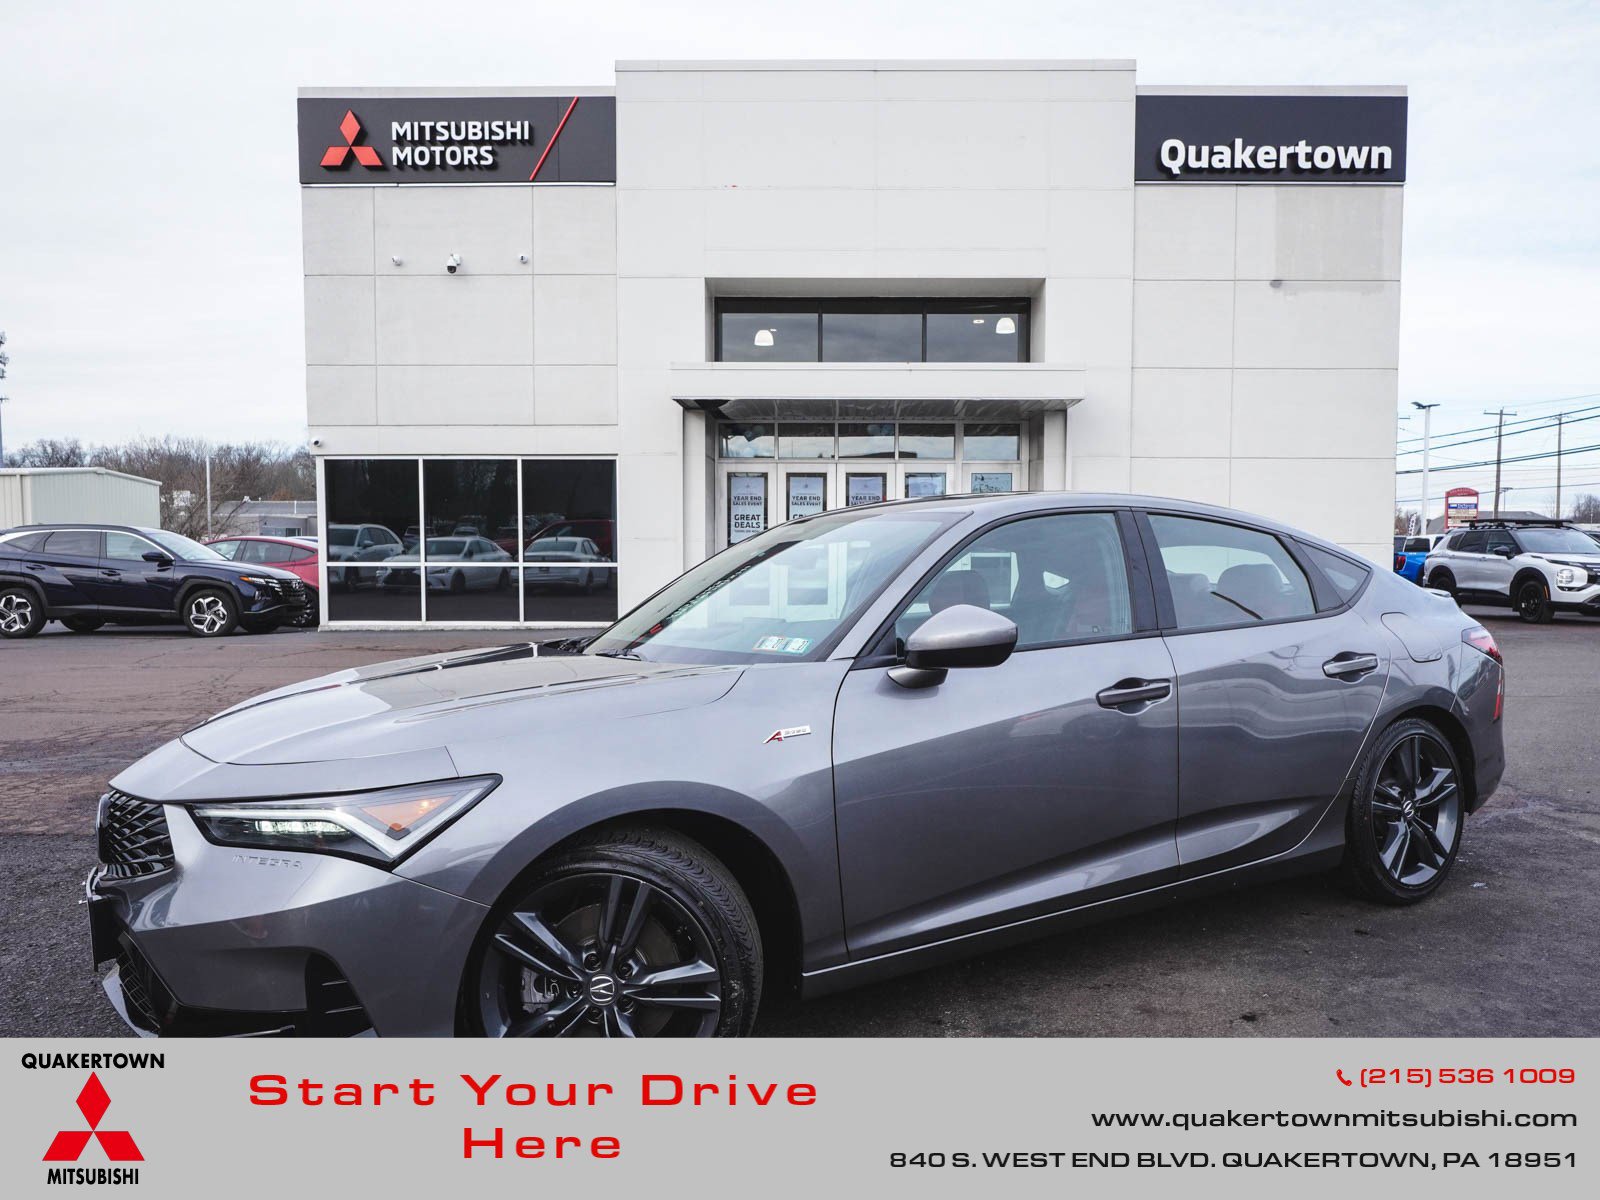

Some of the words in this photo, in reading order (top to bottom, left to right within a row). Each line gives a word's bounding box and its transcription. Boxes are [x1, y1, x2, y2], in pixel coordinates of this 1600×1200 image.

[391, 120, 530, 142] MITSUBISHI
[391, 145, 494, 166] MOTORS
[1160, 138, 1393, 174] Quakertown
[734, 521, 761, 529] DEALS
